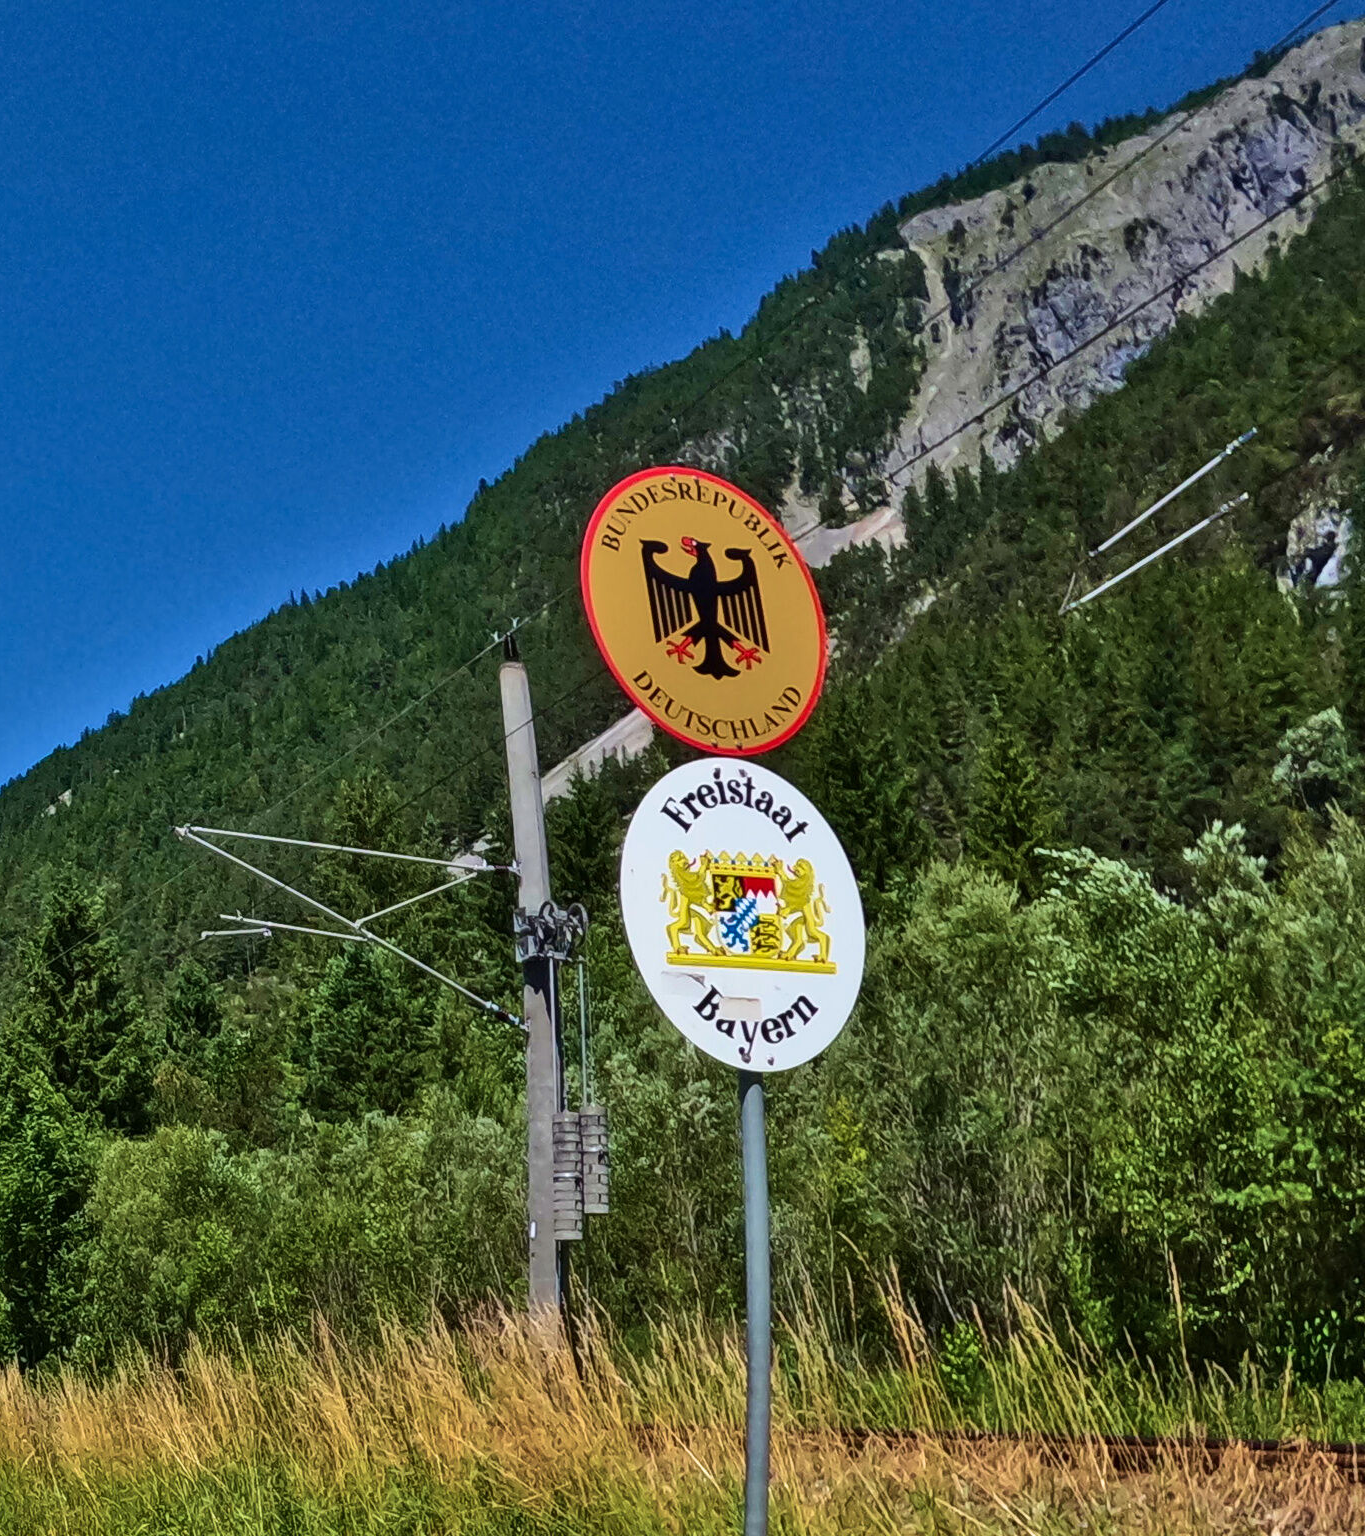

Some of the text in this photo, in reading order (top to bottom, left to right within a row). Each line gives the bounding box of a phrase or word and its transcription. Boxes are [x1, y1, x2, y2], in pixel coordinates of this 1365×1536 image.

[601, 481, 792, 570] BUNDESREPUBLIK
[633, 670, 802, 740] DEUTSCHLAND
[660, 768, 809, 843] Freistaat
[693, 985, 818, 1063] Bayern
